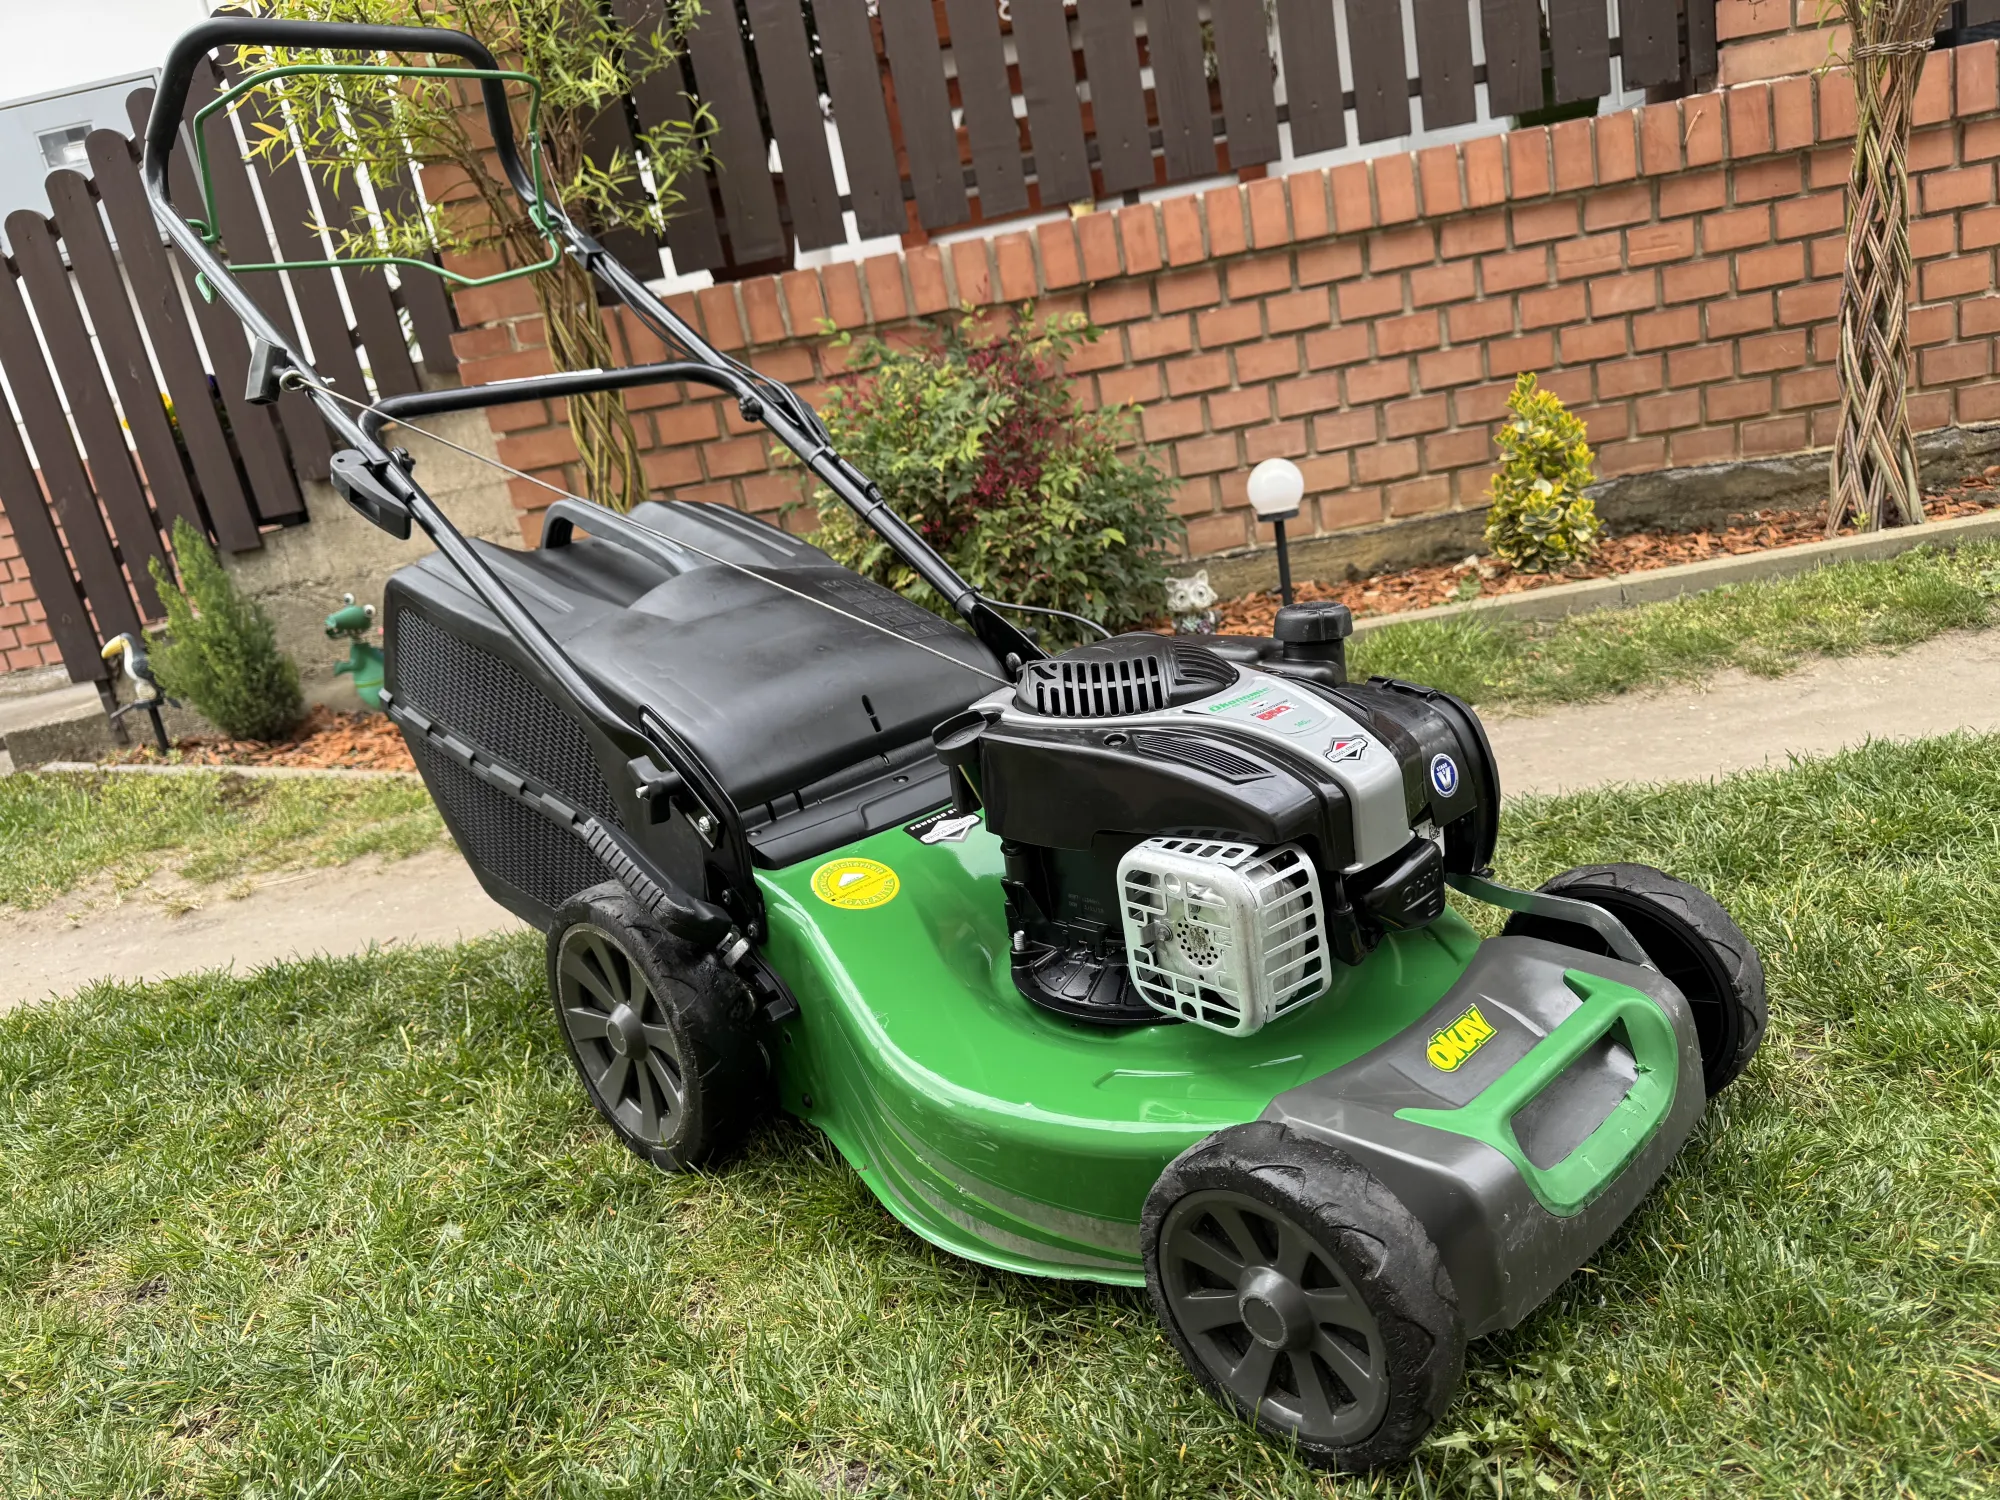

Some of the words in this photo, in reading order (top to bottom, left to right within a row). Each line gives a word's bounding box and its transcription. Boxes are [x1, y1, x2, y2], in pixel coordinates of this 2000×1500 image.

[910, 812, 947, 831] POWERED
[844, 880, 894, 906] GARANTIE
[1427, 1007, 1496, 1071] OKAY
